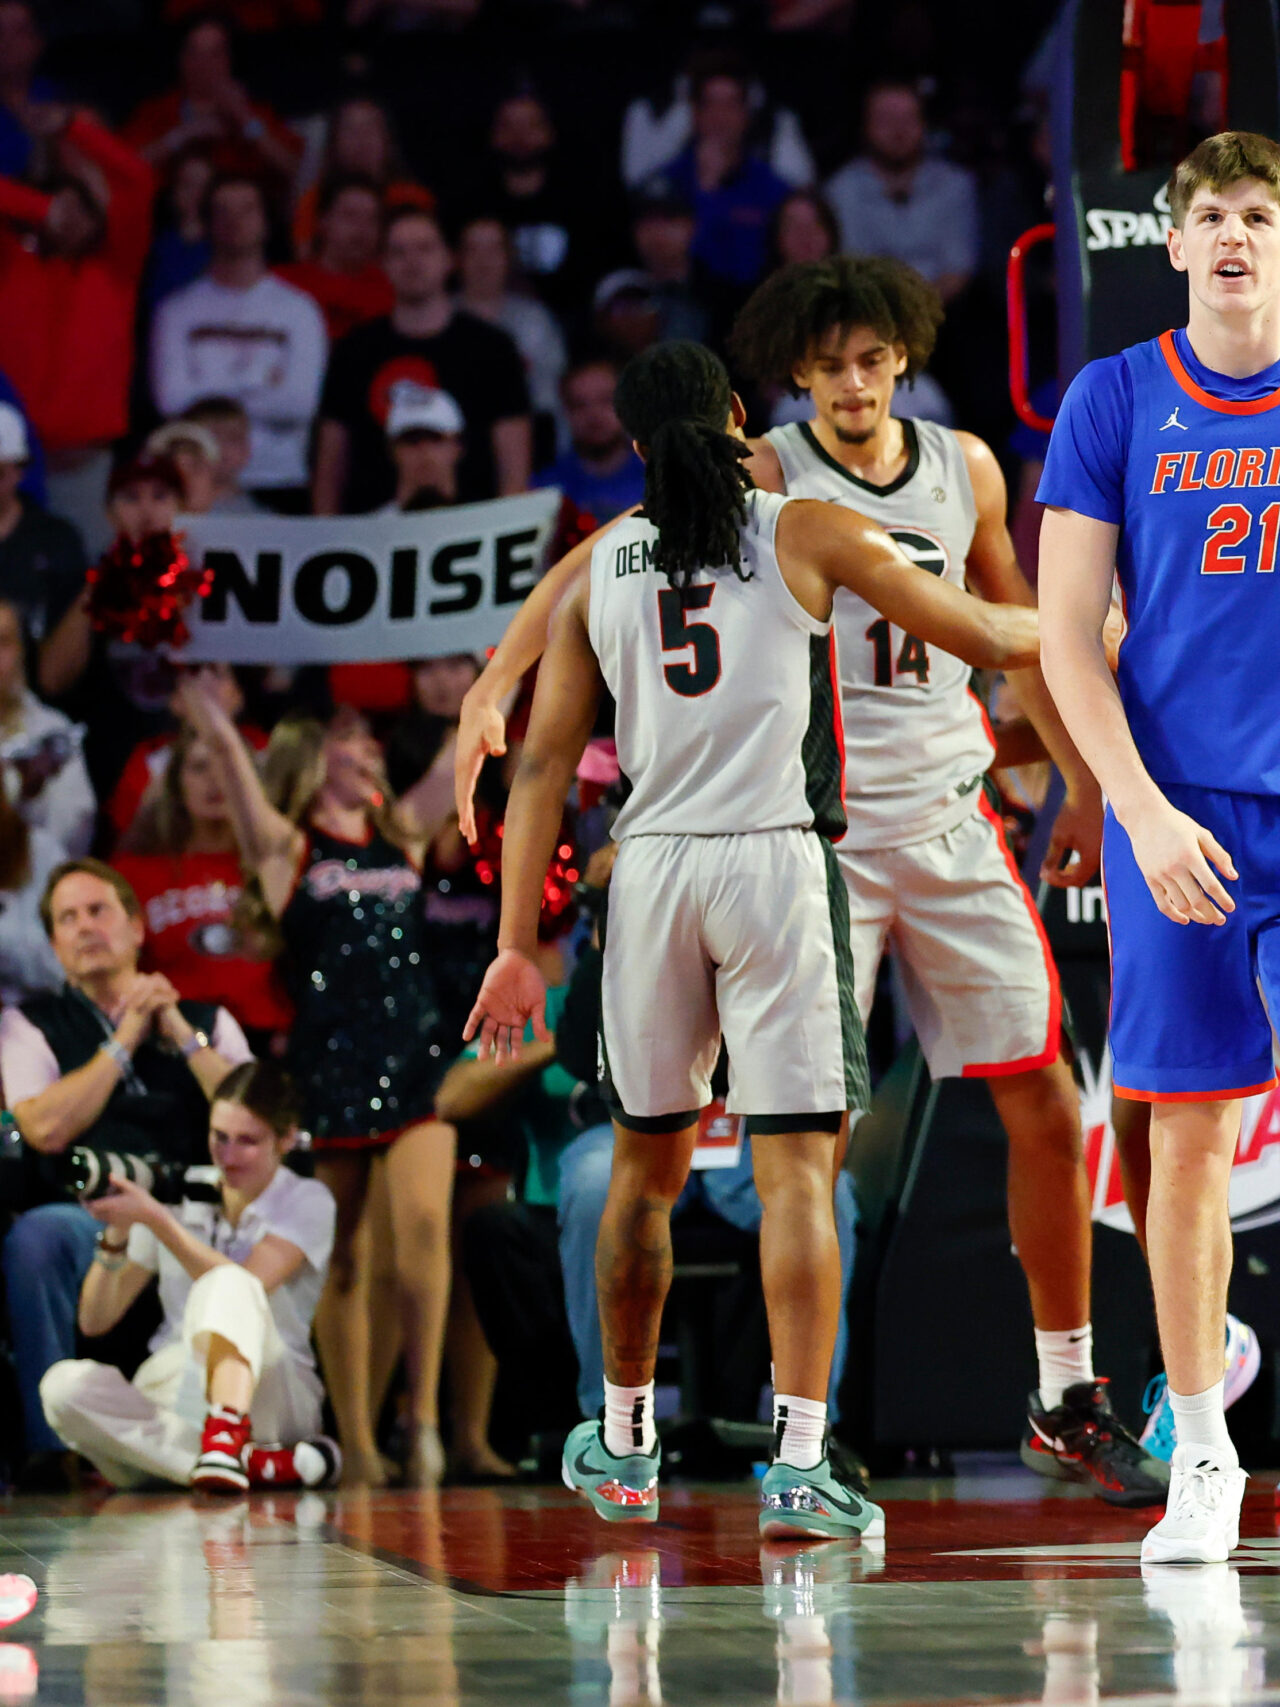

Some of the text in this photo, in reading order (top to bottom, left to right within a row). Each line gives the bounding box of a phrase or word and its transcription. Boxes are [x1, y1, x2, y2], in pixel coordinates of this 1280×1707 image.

[1086, 208, 1173, 251] SPAL
[202, 528, 539, 626] NOISE
[616, 538, 664, 578] DEM
[658, 582, 722, 698] 5
[865, 617, 930, 687] 14
